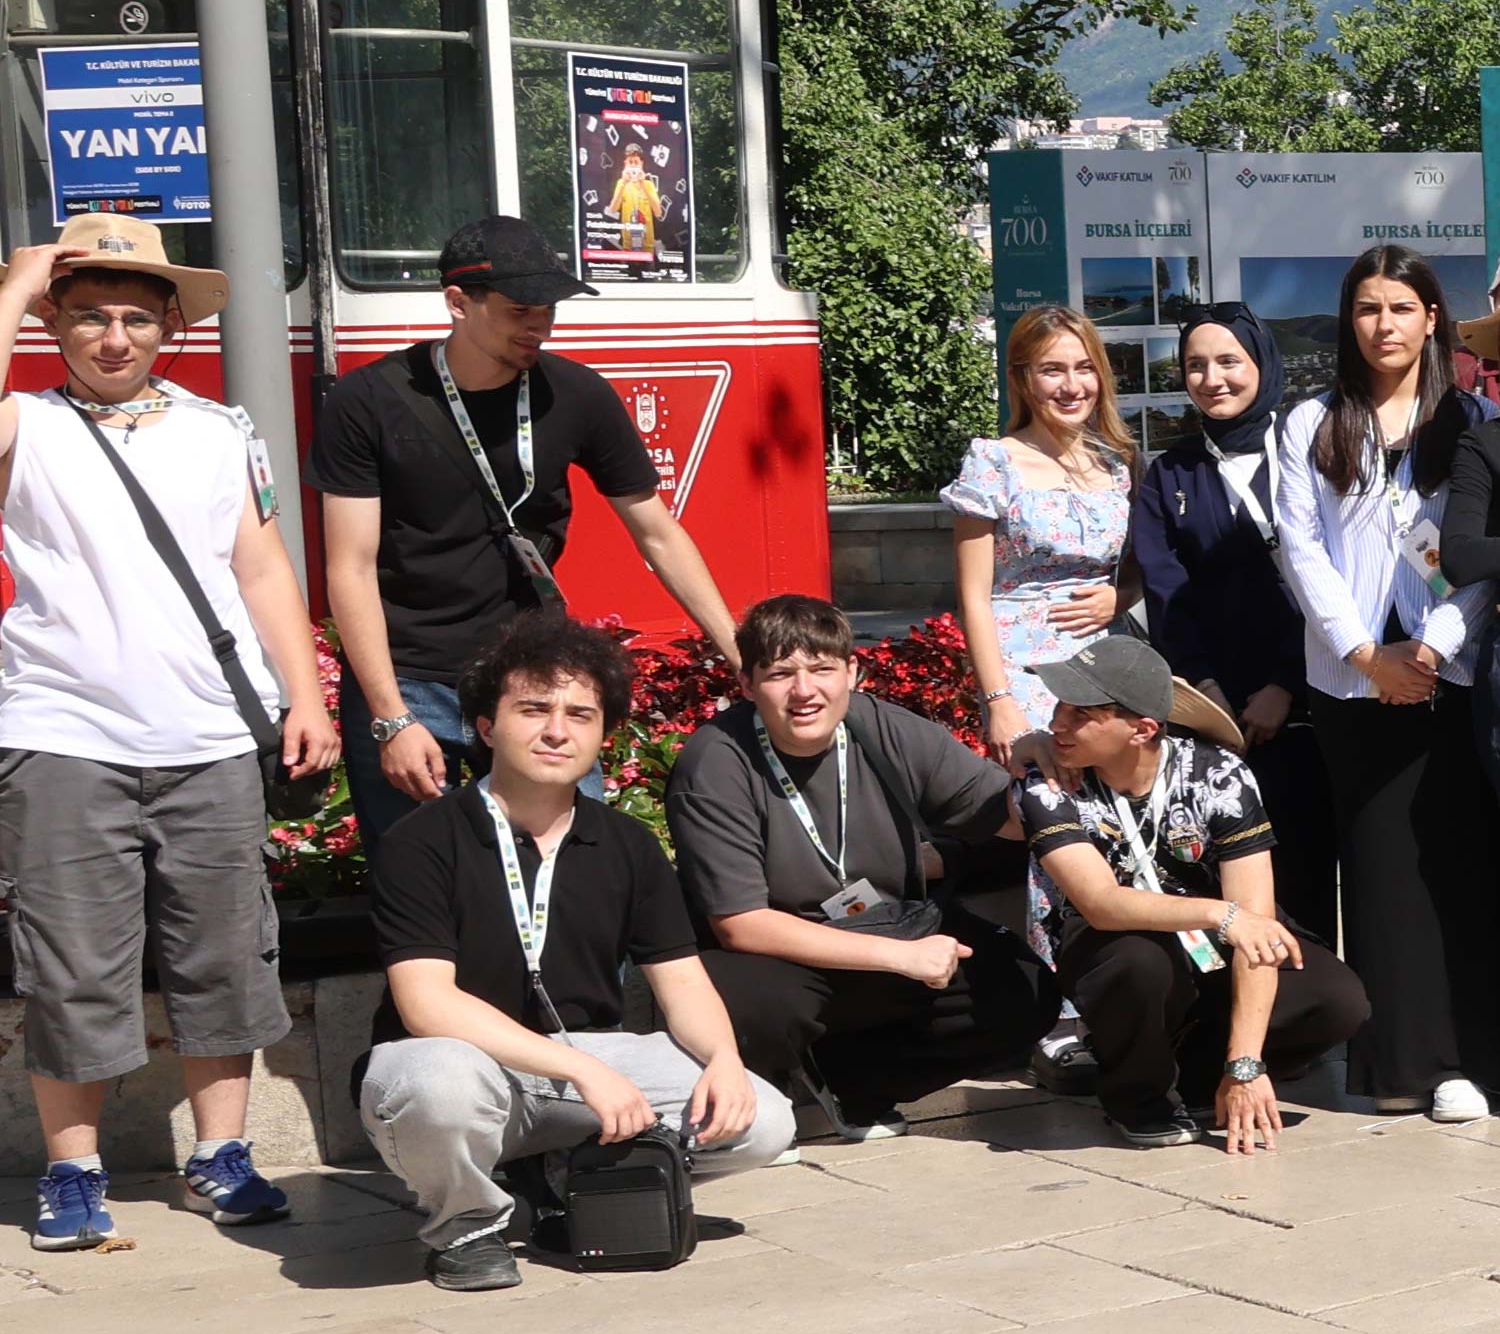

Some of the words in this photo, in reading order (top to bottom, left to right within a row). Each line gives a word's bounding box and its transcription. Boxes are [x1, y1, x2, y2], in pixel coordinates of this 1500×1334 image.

[86, 62, 99, 70] T.C.
[173, 58, 200, 67] BAKAN
[131, 91, 174, 104] vivo
[60, 128, 139, 158] YAN
[145, 126, 207, 155] YA
[1095, 172, 1118, 182] VAKIF
[1120, 172, 1152, 181] KATILIM
[1168, 167, 1191, 180] 700
[1260, 174, 1290, 183] VAKIF
[1292, 174, 1336, 183] KATILIM
[1414, 171, 1445, 185] 700
[1000, 217, 1047, 246] 700
[1085, 223, 1131, 237] BURSA
[1135, 220, 1192, 240] İLÇELERİ
[1362, 225, 1421, 238] BURSA
[1427, 220, 1485, 241] İLÇELE
